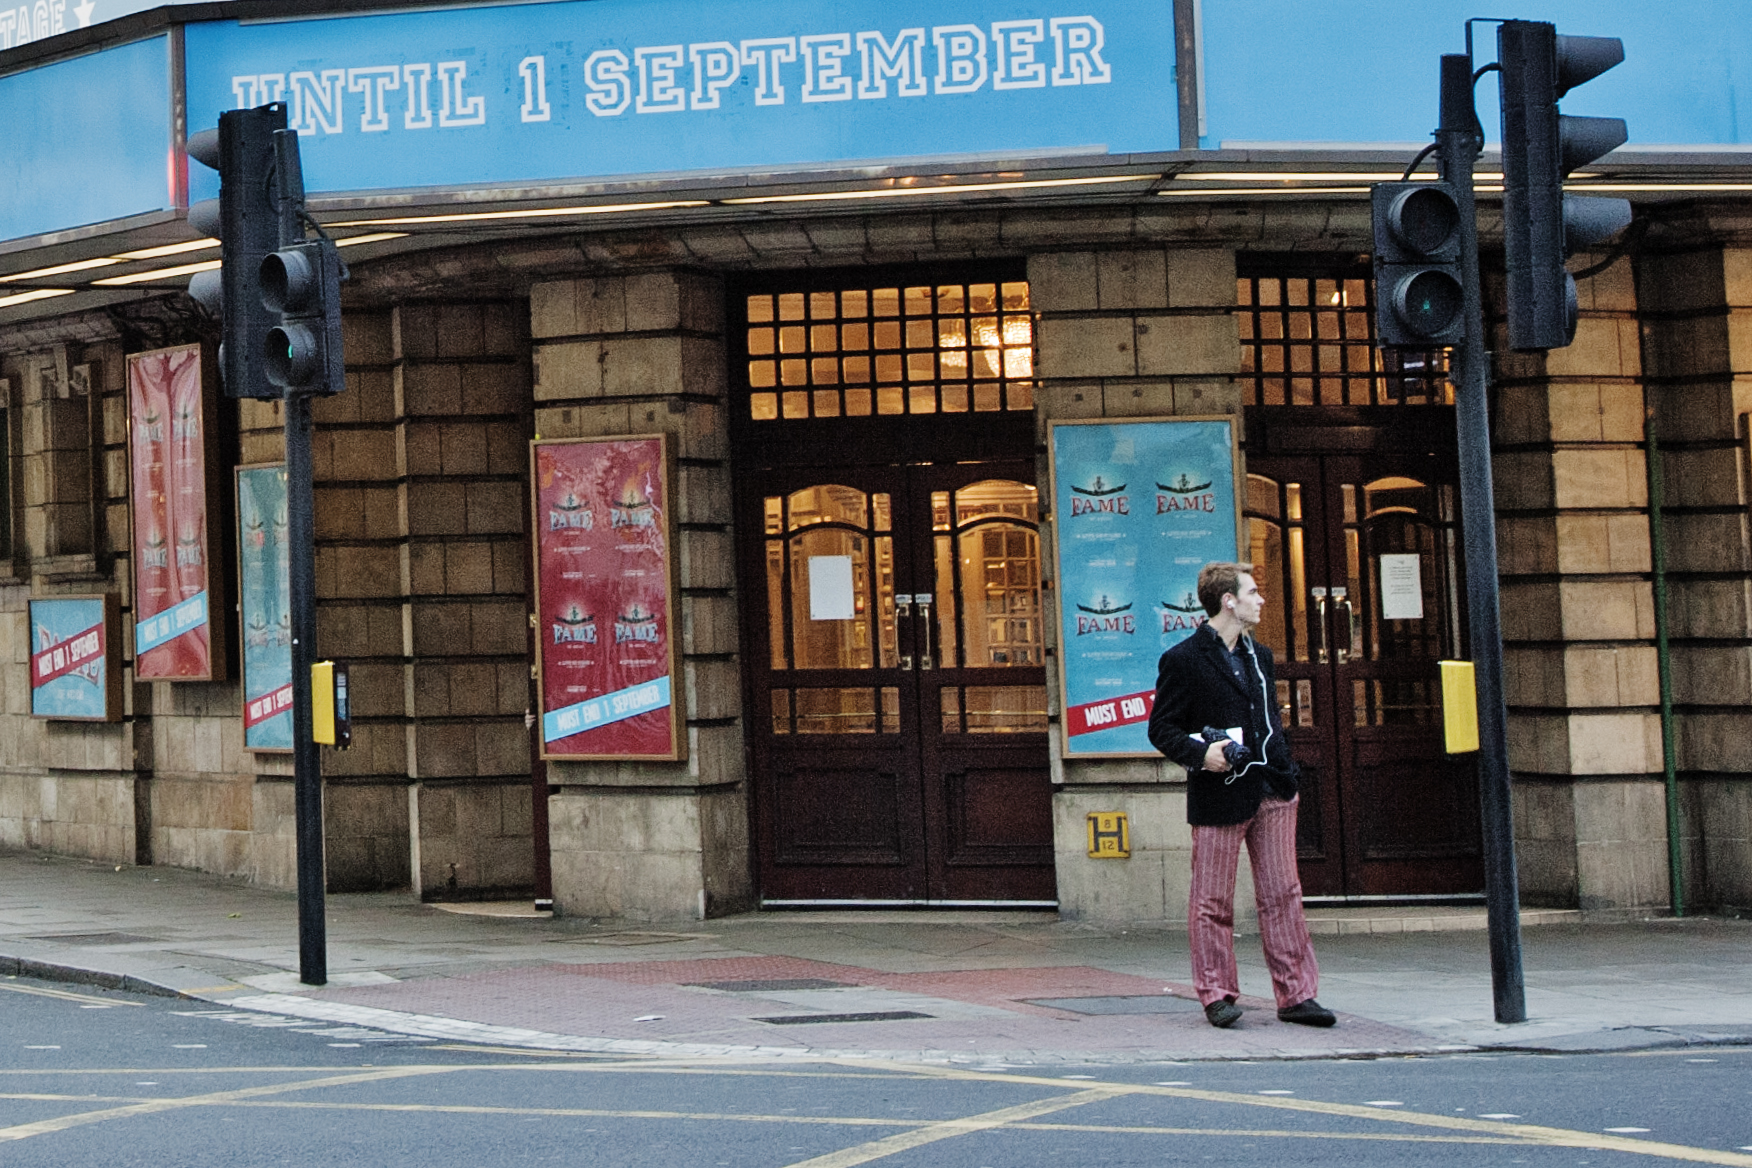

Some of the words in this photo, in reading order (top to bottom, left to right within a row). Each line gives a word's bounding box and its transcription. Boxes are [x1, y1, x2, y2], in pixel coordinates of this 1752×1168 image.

[232, 60, 485, 136] UNTIL
[518, 55, 551, 123] 1
[585, 15, 1112, 119] SEPTEMBER
[1070, 496, 1130, 518] FAME
[1156, 493, 1215, 515] FAME
[550, 510, 593, 531] FAME
[611, 507, 654, 529] FAME
[553, 623, 597, 644] FAME
[615, 623, 658, 643] FAME
[1076, 615, 1136, 636] FAME
[1162, 614, 1205, 635] FAM
[557, 708, 581, 731] MUST
[582, 702, 601, 724] END
[603, 699, 610, 718] 1
[612, 685, 660, 714] SEPTEMBER
[1084, 703, 1117, 728] MUST
[1121, 697, 1146, 720] END
[1104, 819, 1111, 829] 8
[1102, 840, 1115, 850] 12
